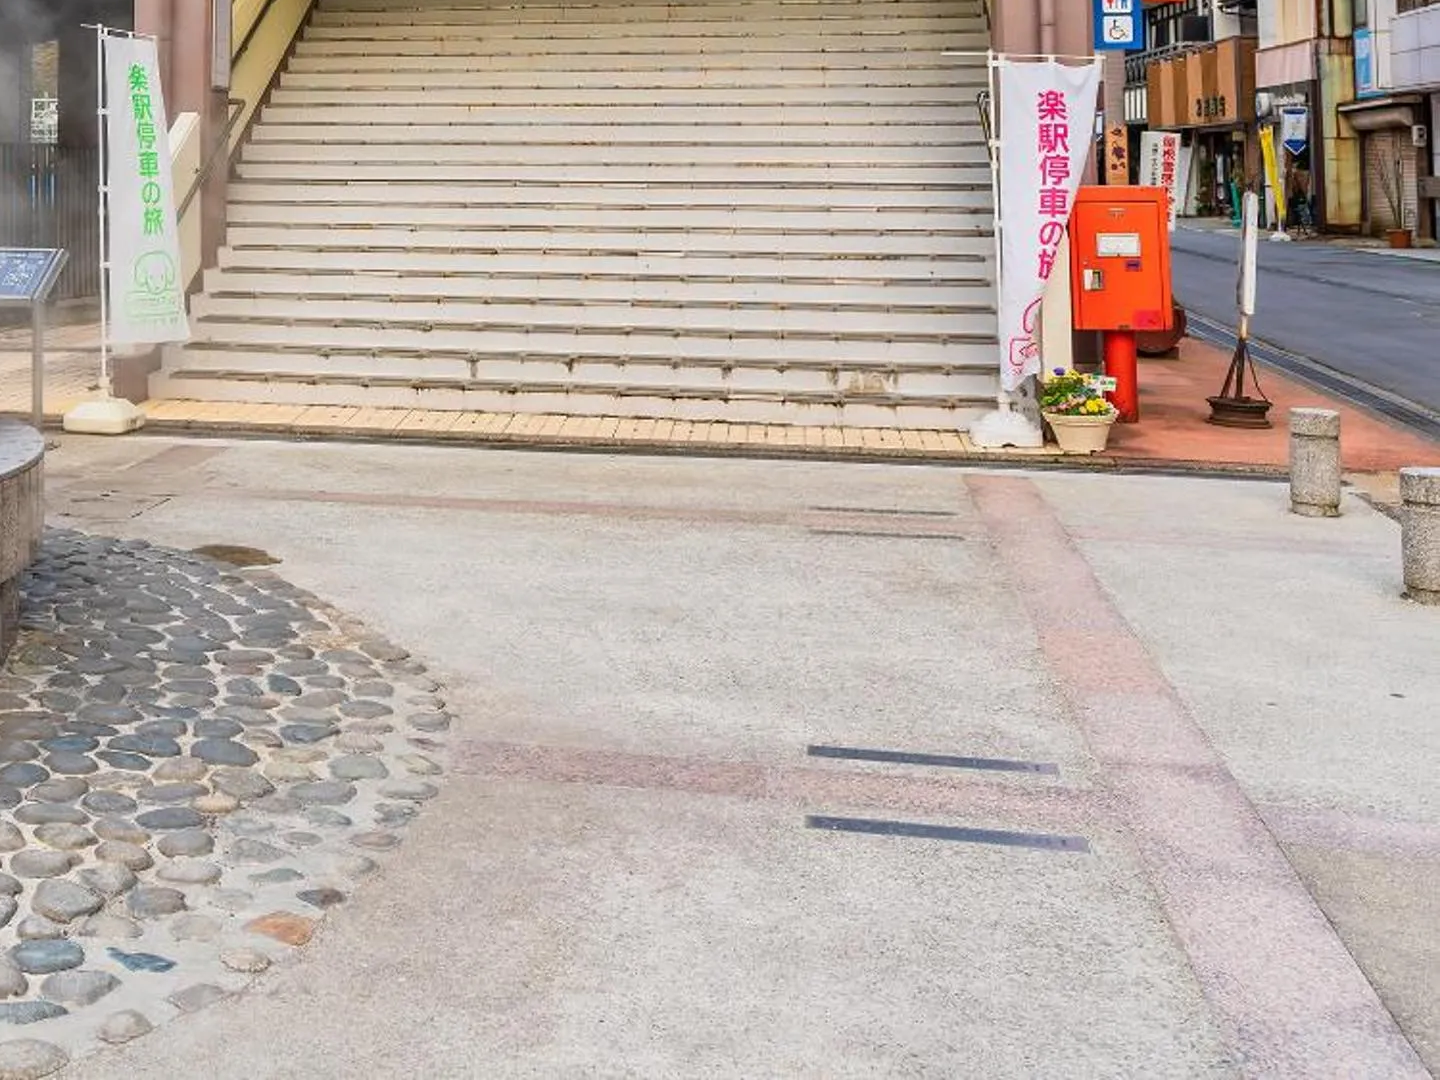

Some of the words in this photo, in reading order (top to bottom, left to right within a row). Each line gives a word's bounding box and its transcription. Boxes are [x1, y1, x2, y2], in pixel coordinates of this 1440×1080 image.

[128, 63, 164, 236] 楽駅停車の旅
